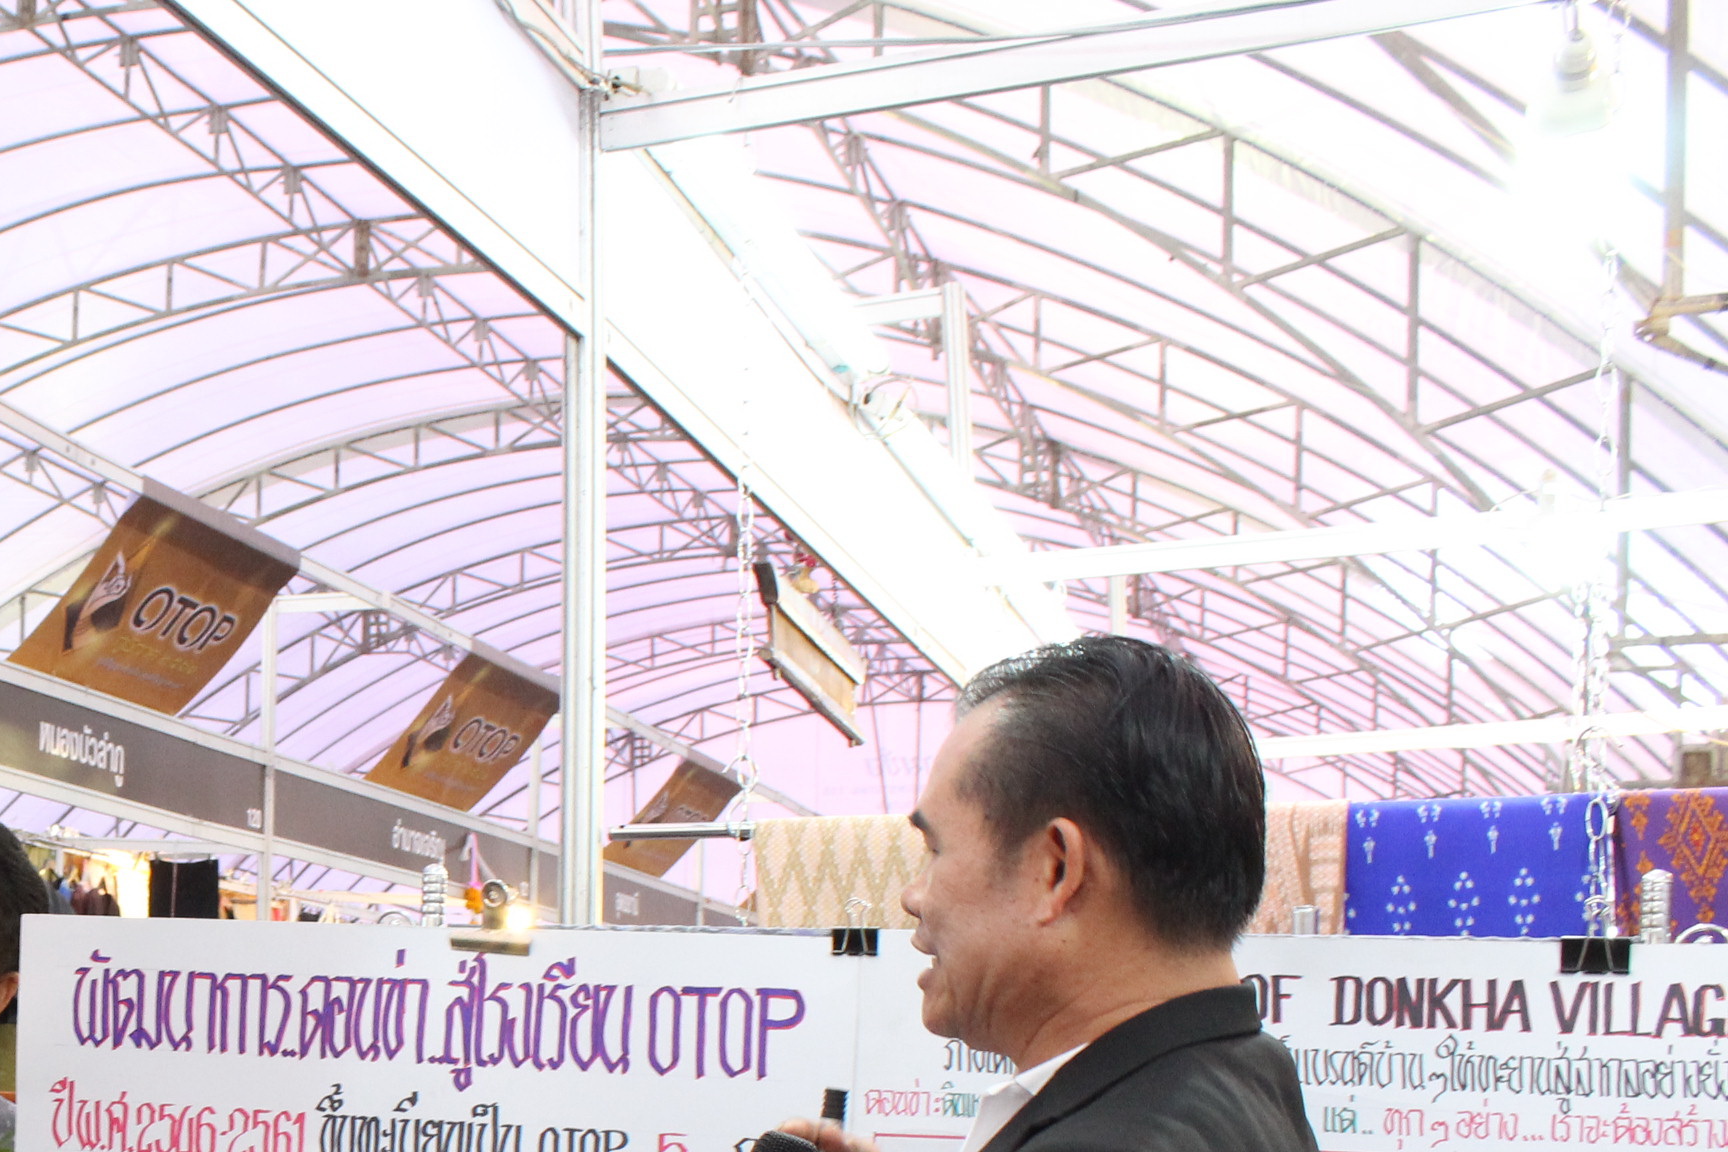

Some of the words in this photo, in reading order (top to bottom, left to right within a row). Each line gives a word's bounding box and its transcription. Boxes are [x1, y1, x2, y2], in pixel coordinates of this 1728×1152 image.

[132, 587, 236, 651] OTOP
[452, 717, 520, 762] OTOP
[648, 985, 805, 1080] OTOP
[1328, 975, 1533, 1034] DONKHA
